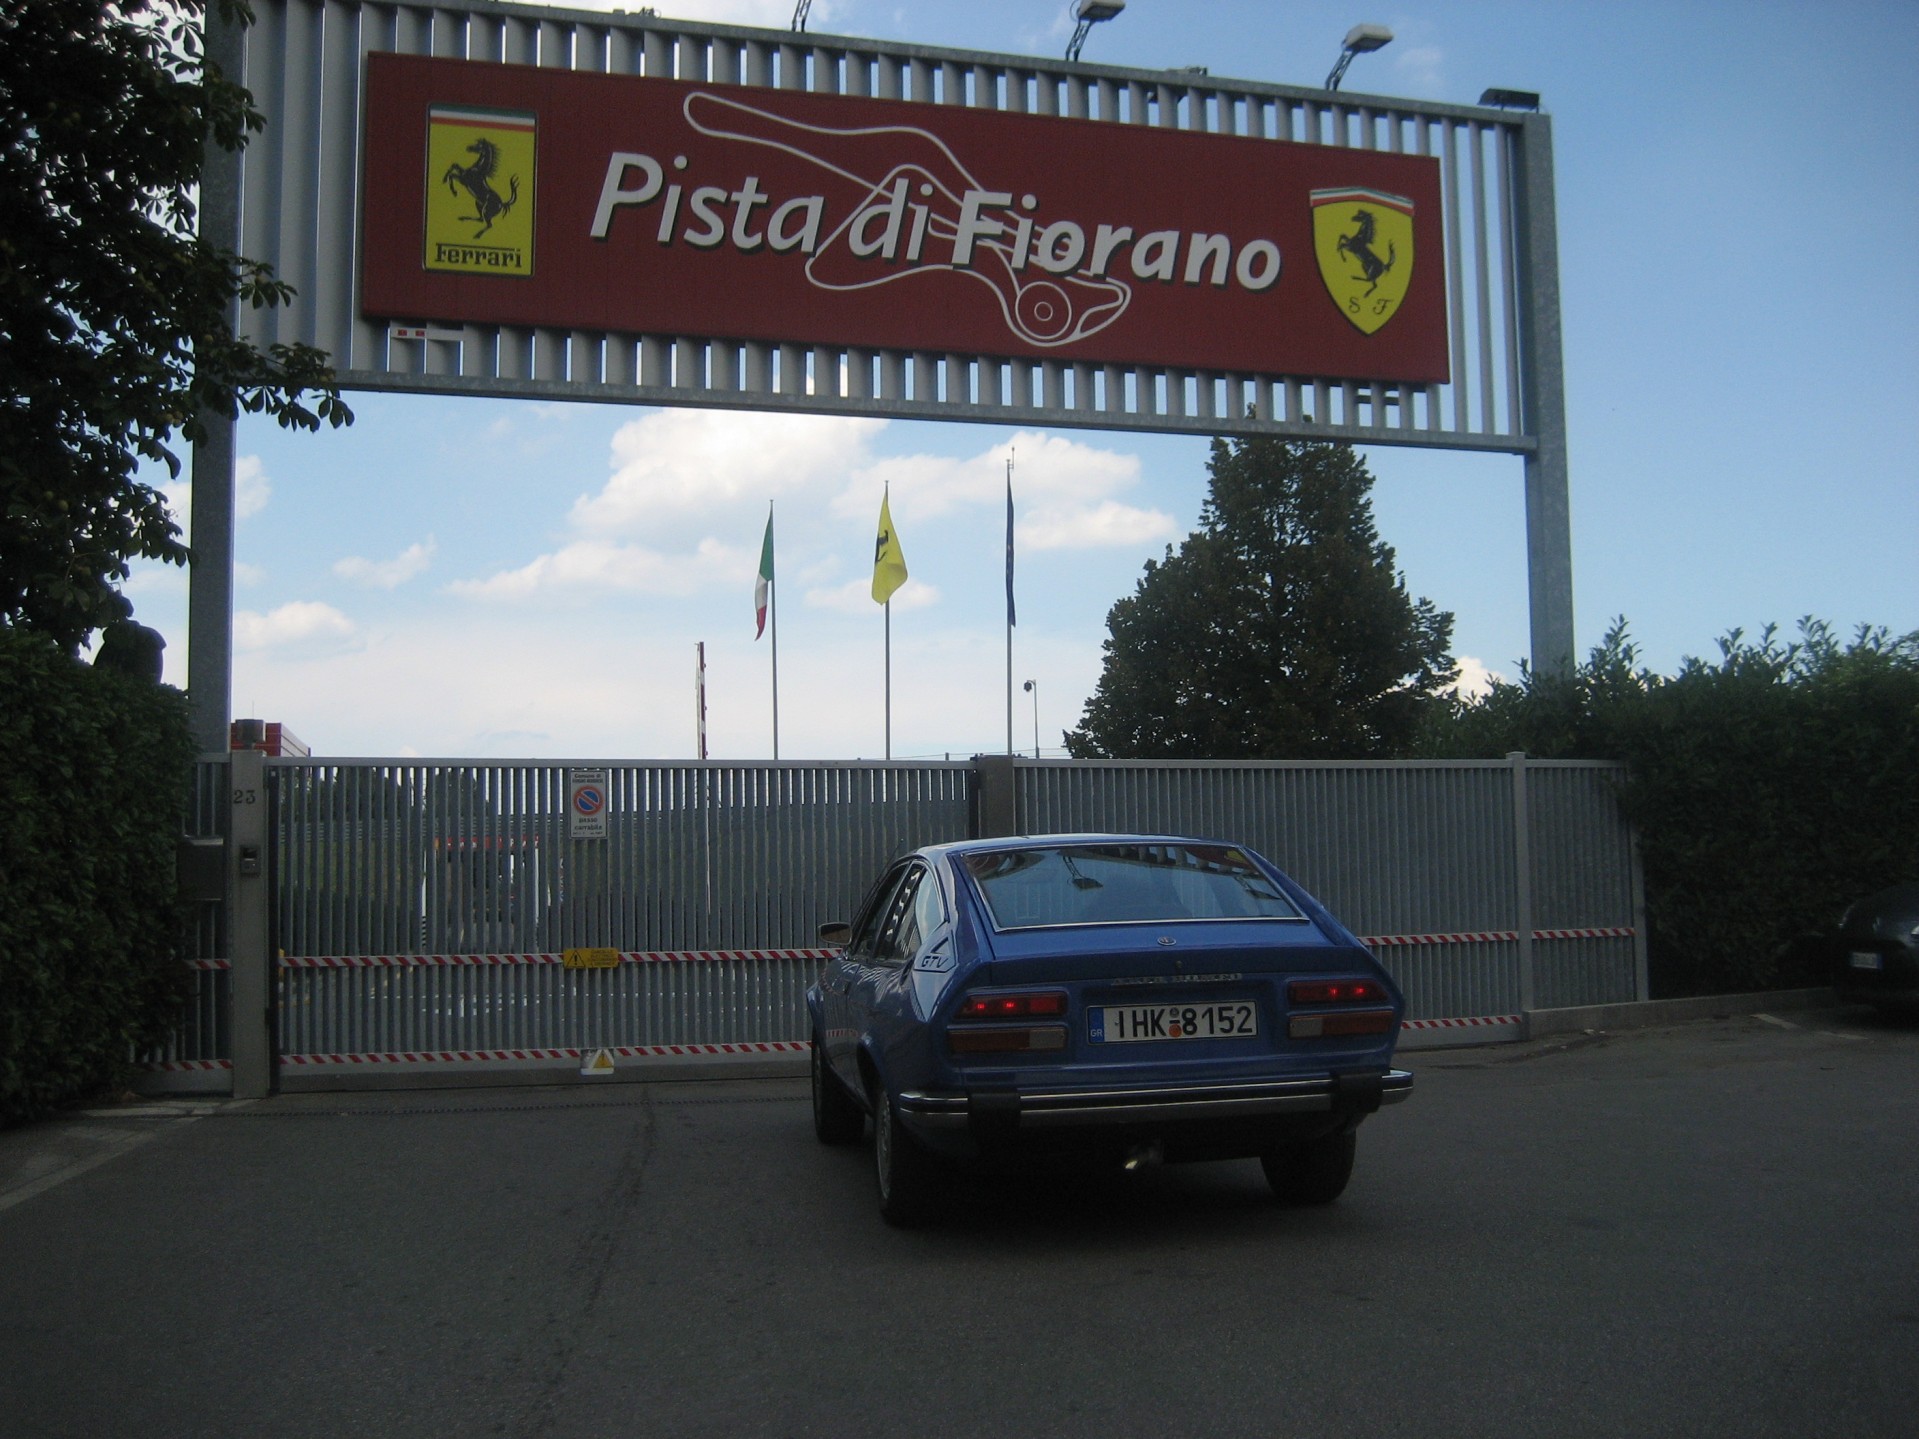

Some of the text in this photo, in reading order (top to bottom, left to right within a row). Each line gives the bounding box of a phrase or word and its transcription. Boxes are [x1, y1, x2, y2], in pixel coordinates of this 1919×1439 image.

[590, 151, 1282, 290] Pista di Fiorano
[435, 243, 522, 268] Ferrari
[233, 789, 256, 805] 23
[921, 955, 949, 968] GTV
[1090, 1029, 1103, 1037] GR
